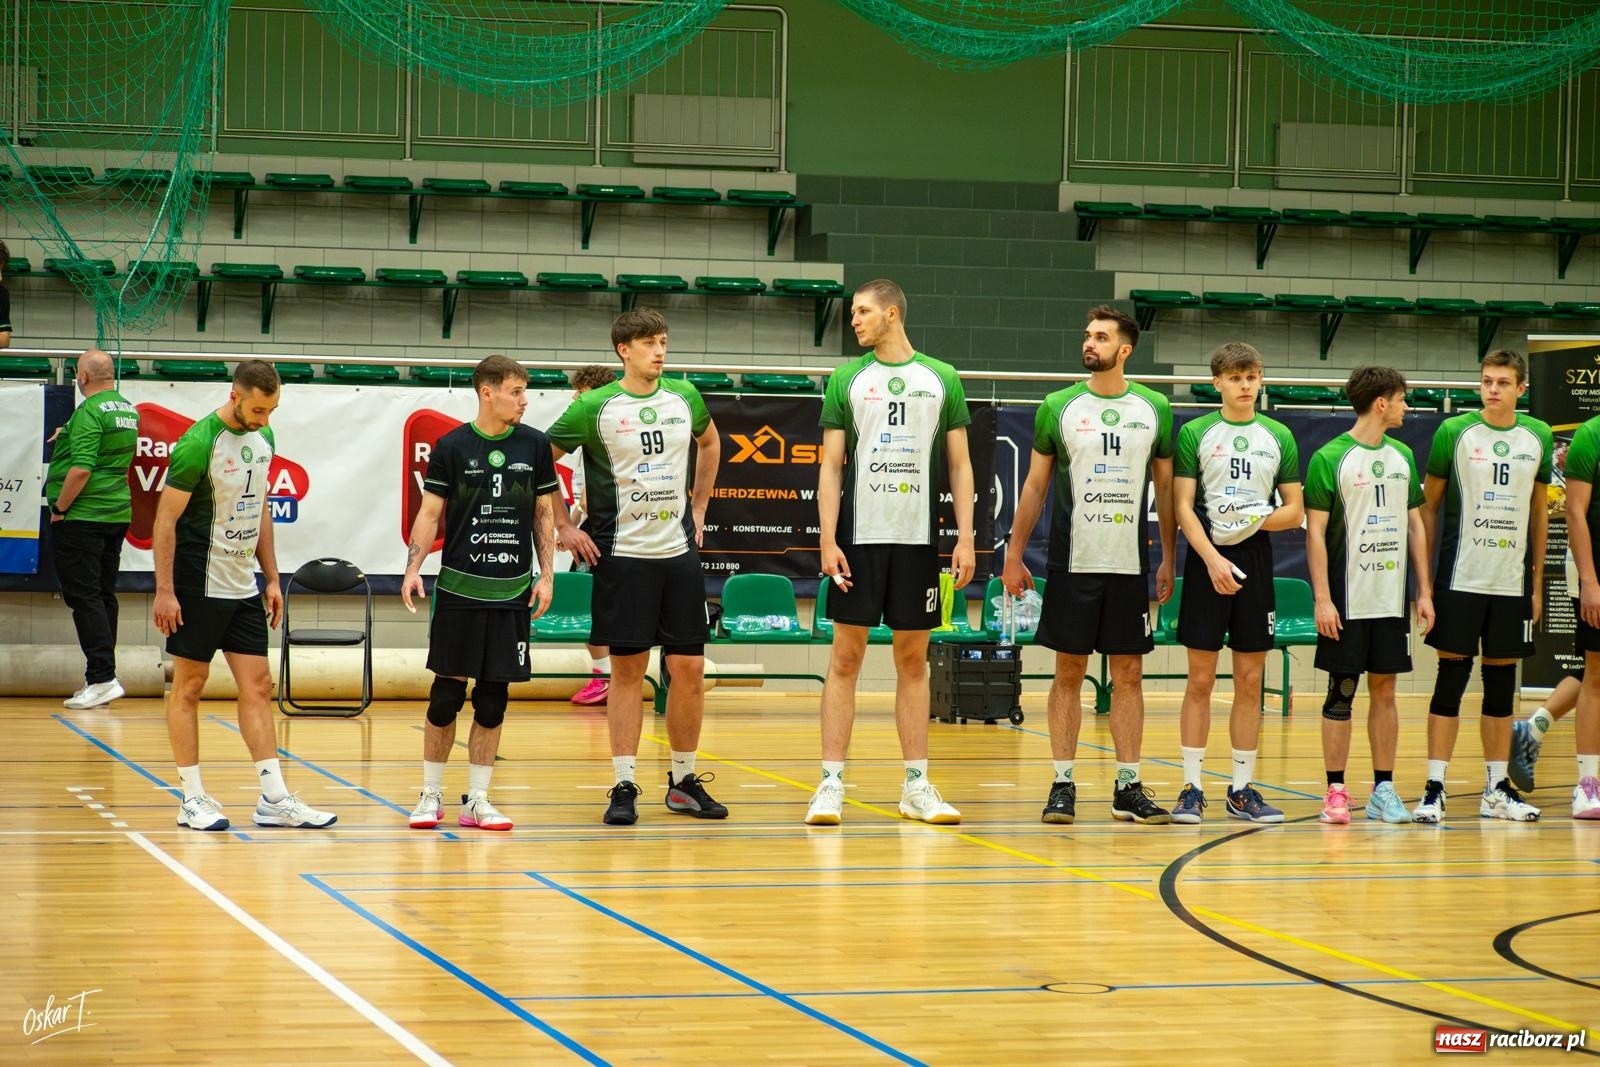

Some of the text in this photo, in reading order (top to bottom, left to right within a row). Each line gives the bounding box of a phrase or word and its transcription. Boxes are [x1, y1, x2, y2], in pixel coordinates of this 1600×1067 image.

[1566, 369, 1600, 384] SZY
[888, 401, 906, 426] 21
[640, 430, 664, 455] 99
[1101, 433, 1121, 456] 14
[1230, 457, 1251, 480] 54
[1492, 463, 1510, 485] 16
[492, 474, 503, 497] 3
[869, 482, 921, 494] VISON
[801, 490, 815, 501] W
[1375, 484, 1386, 507] 11
[3, 501, 12, 513] 2
[630, 510, 679, 522] VISON
[1084, 512, 1134, 524] VISON
[732, 525, 792, 533] KONSTRUKCJE
[1473, 537, 1517, 549] VISON
[470, 551, 520, 563] VISON
[711, 562, 725, 570] 110
[925, 587, 938, 613] 21
[517, 641, 527, 666] 3
